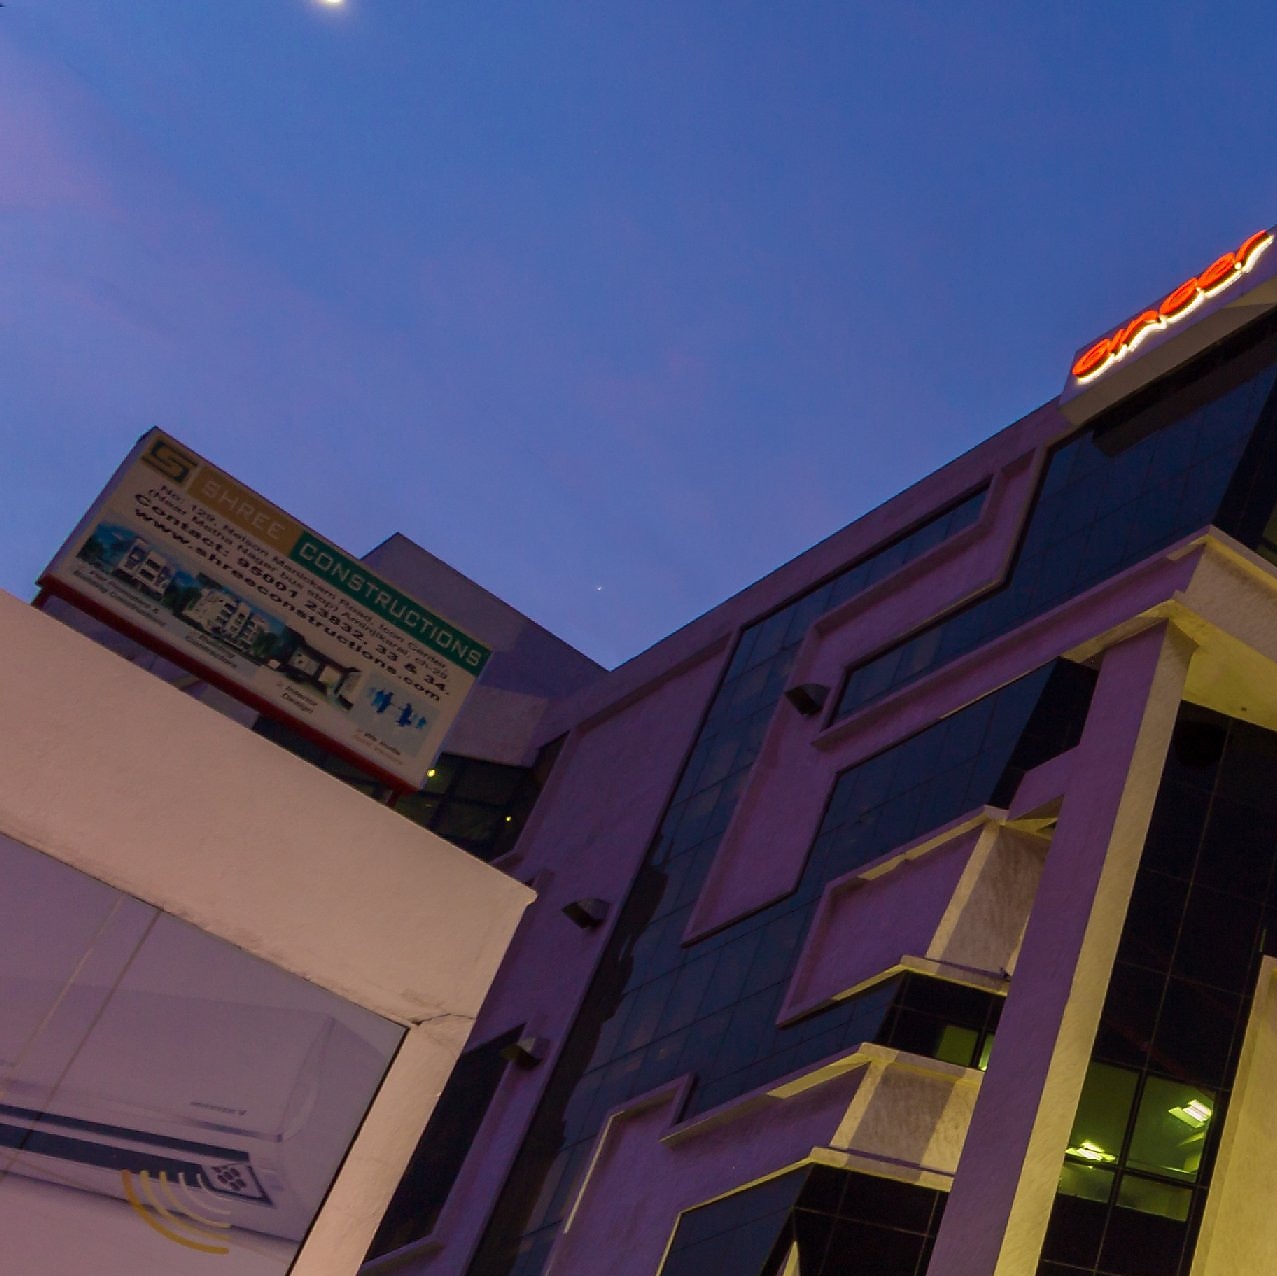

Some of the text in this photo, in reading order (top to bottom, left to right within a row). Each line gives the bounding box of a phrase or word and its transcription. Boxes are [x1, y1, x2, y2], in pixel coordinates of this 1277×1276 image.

[132, 491, 231, 557] Contact:
[403, 660, 419, 675] &
[132, 506, 441, 702] www.shreeconstructions.com
[200, 477, 286, 541] SHREE
[297, 539, 482, 670] CONSTRUCTIONS
